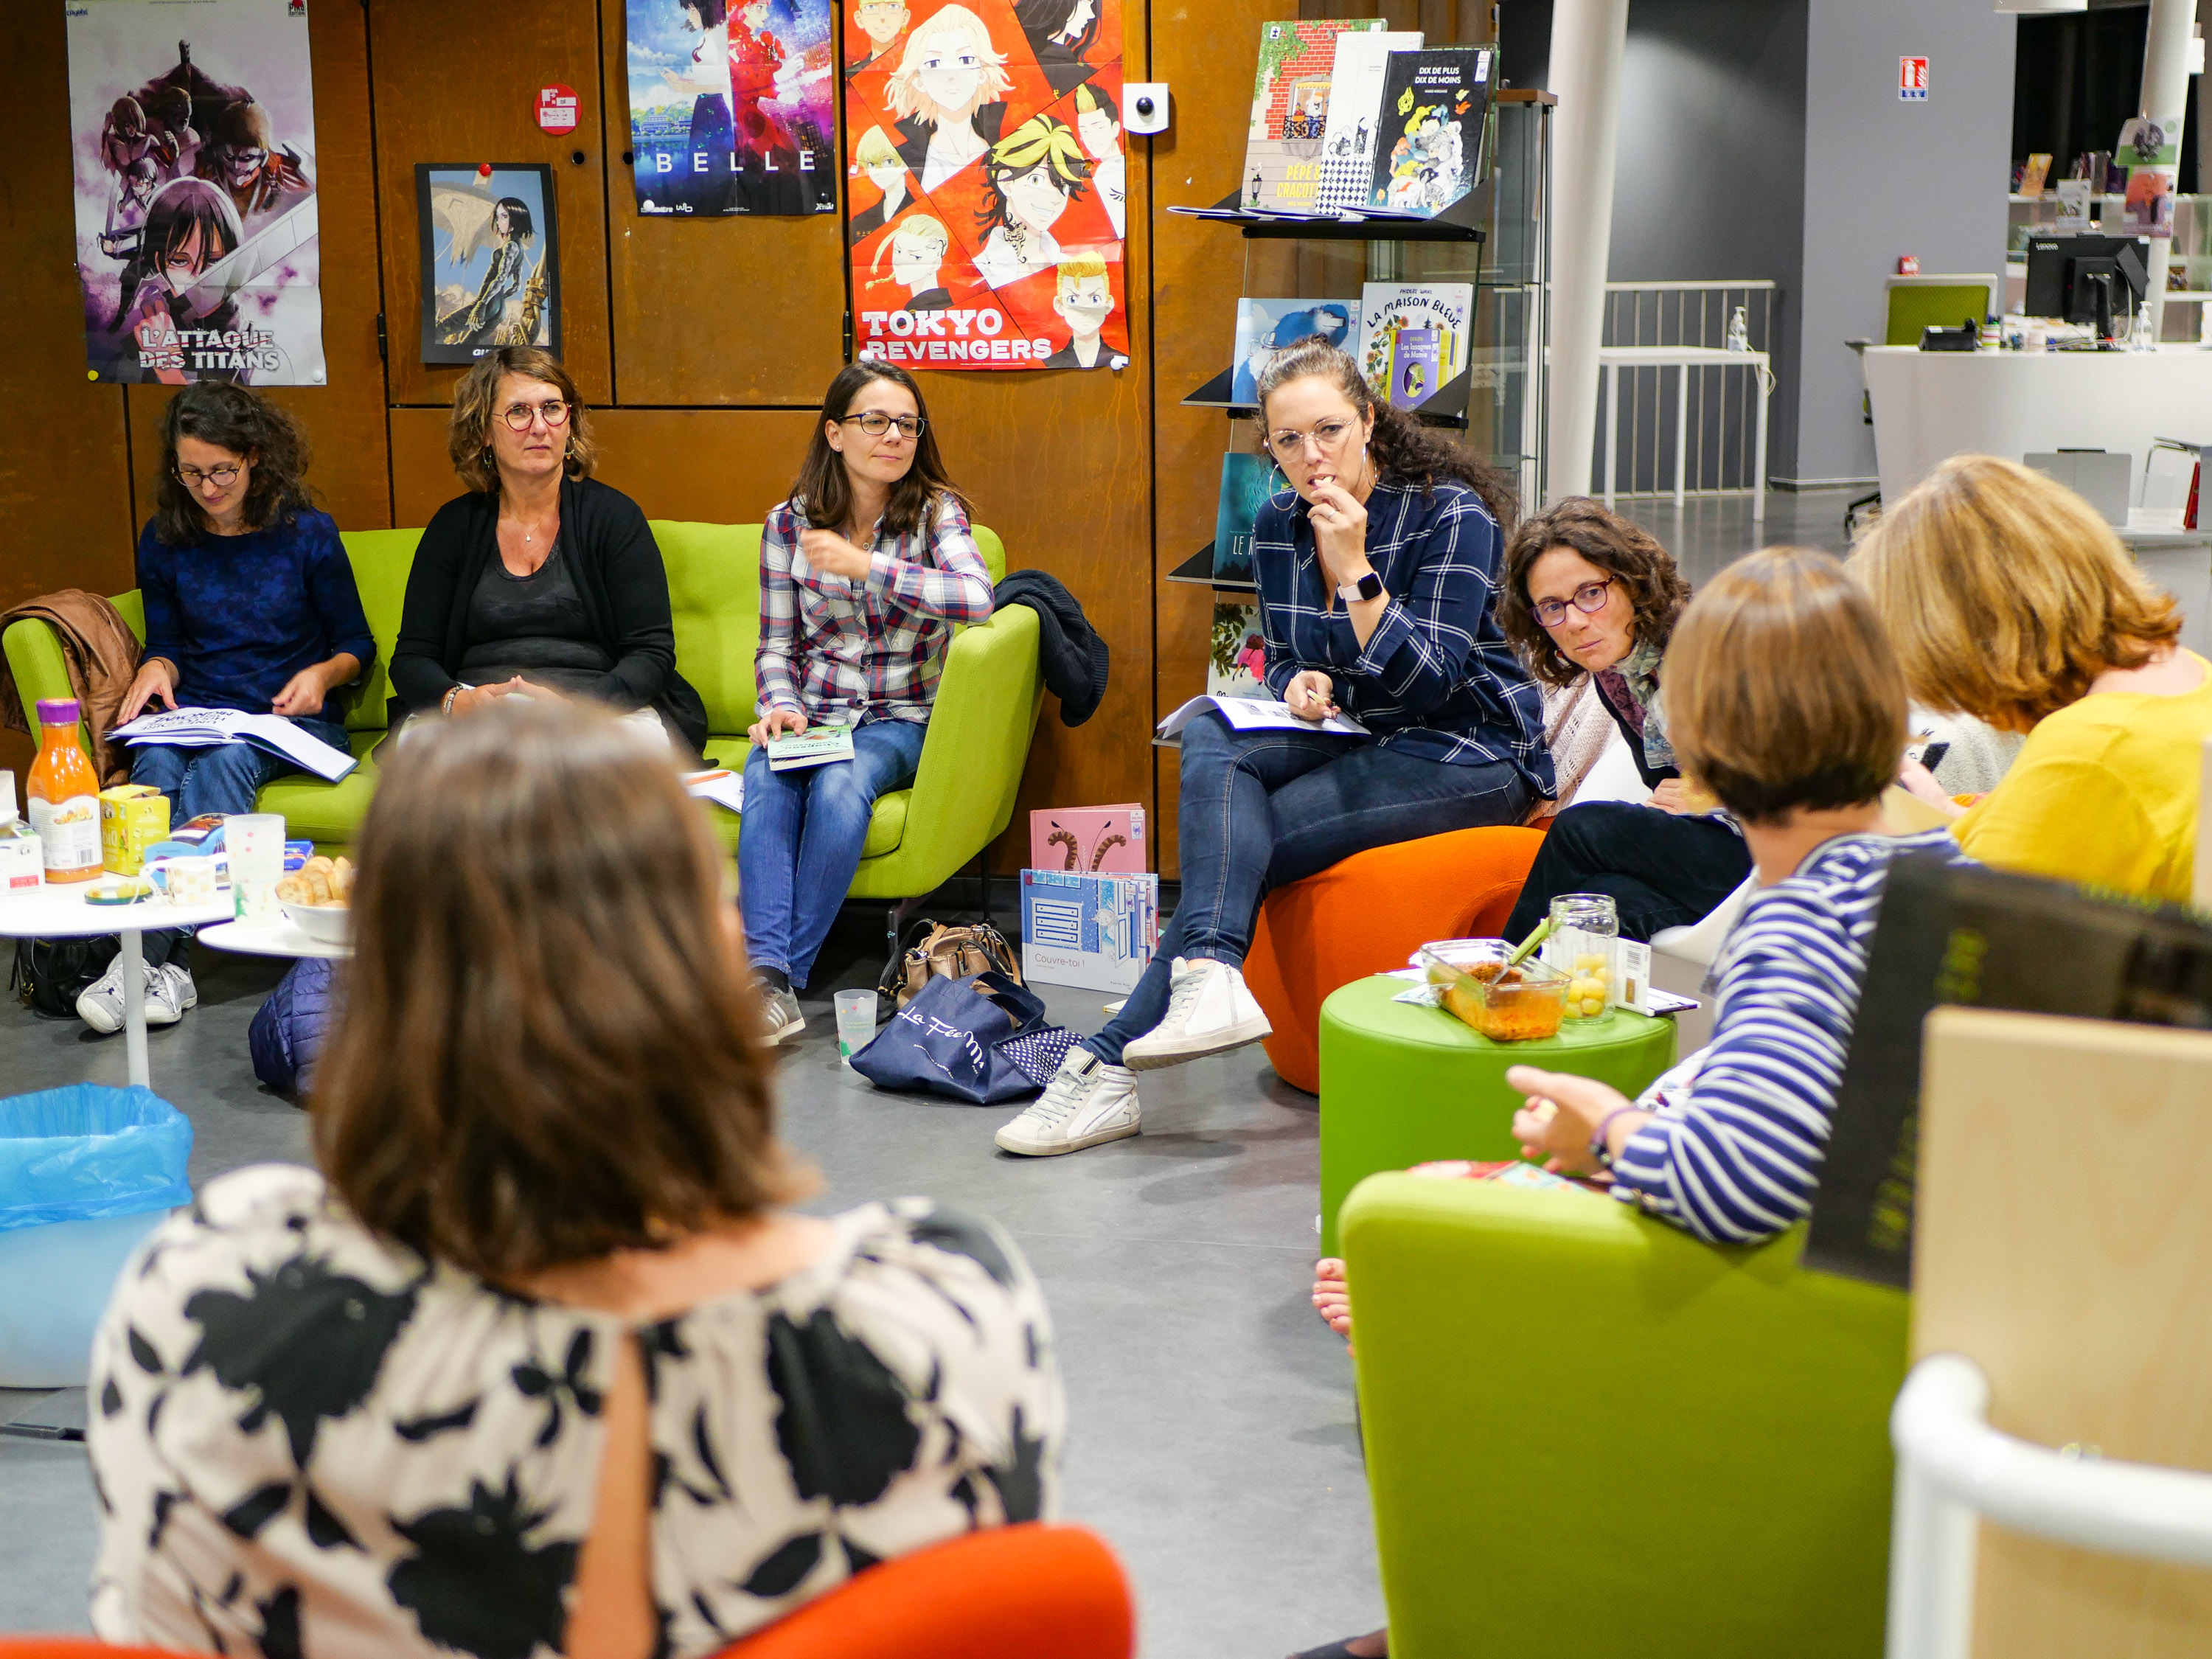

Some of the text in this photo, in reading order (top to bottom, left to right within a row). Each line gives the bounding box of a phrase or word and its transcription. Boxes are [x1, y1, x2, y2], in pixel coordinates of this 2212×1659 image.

[655, 150, 815, 173] BELLE
[1286, 161, 1314, 180] PÉPÉ
[1276, 182, 1319, 198] CRACOTT
[861, 308, 1003, 336] TOKYO
[1367, 297, 1461, 330] LA MAISON BLEUE
[866, 338, 1052, 361] REVENGERS
[1410, 343, 1432, 353] lasagnes
[1411, 350, 1427, 358] Mamie
[139, 349, 280, 369] DES TITANS
[1233, 535, 1245, 555] LE
[1034, 953, 1085, 967] Couvre-toi !
[897, 1006, 926, 1026] La
[926, 1016, 963, 1038] Fée
